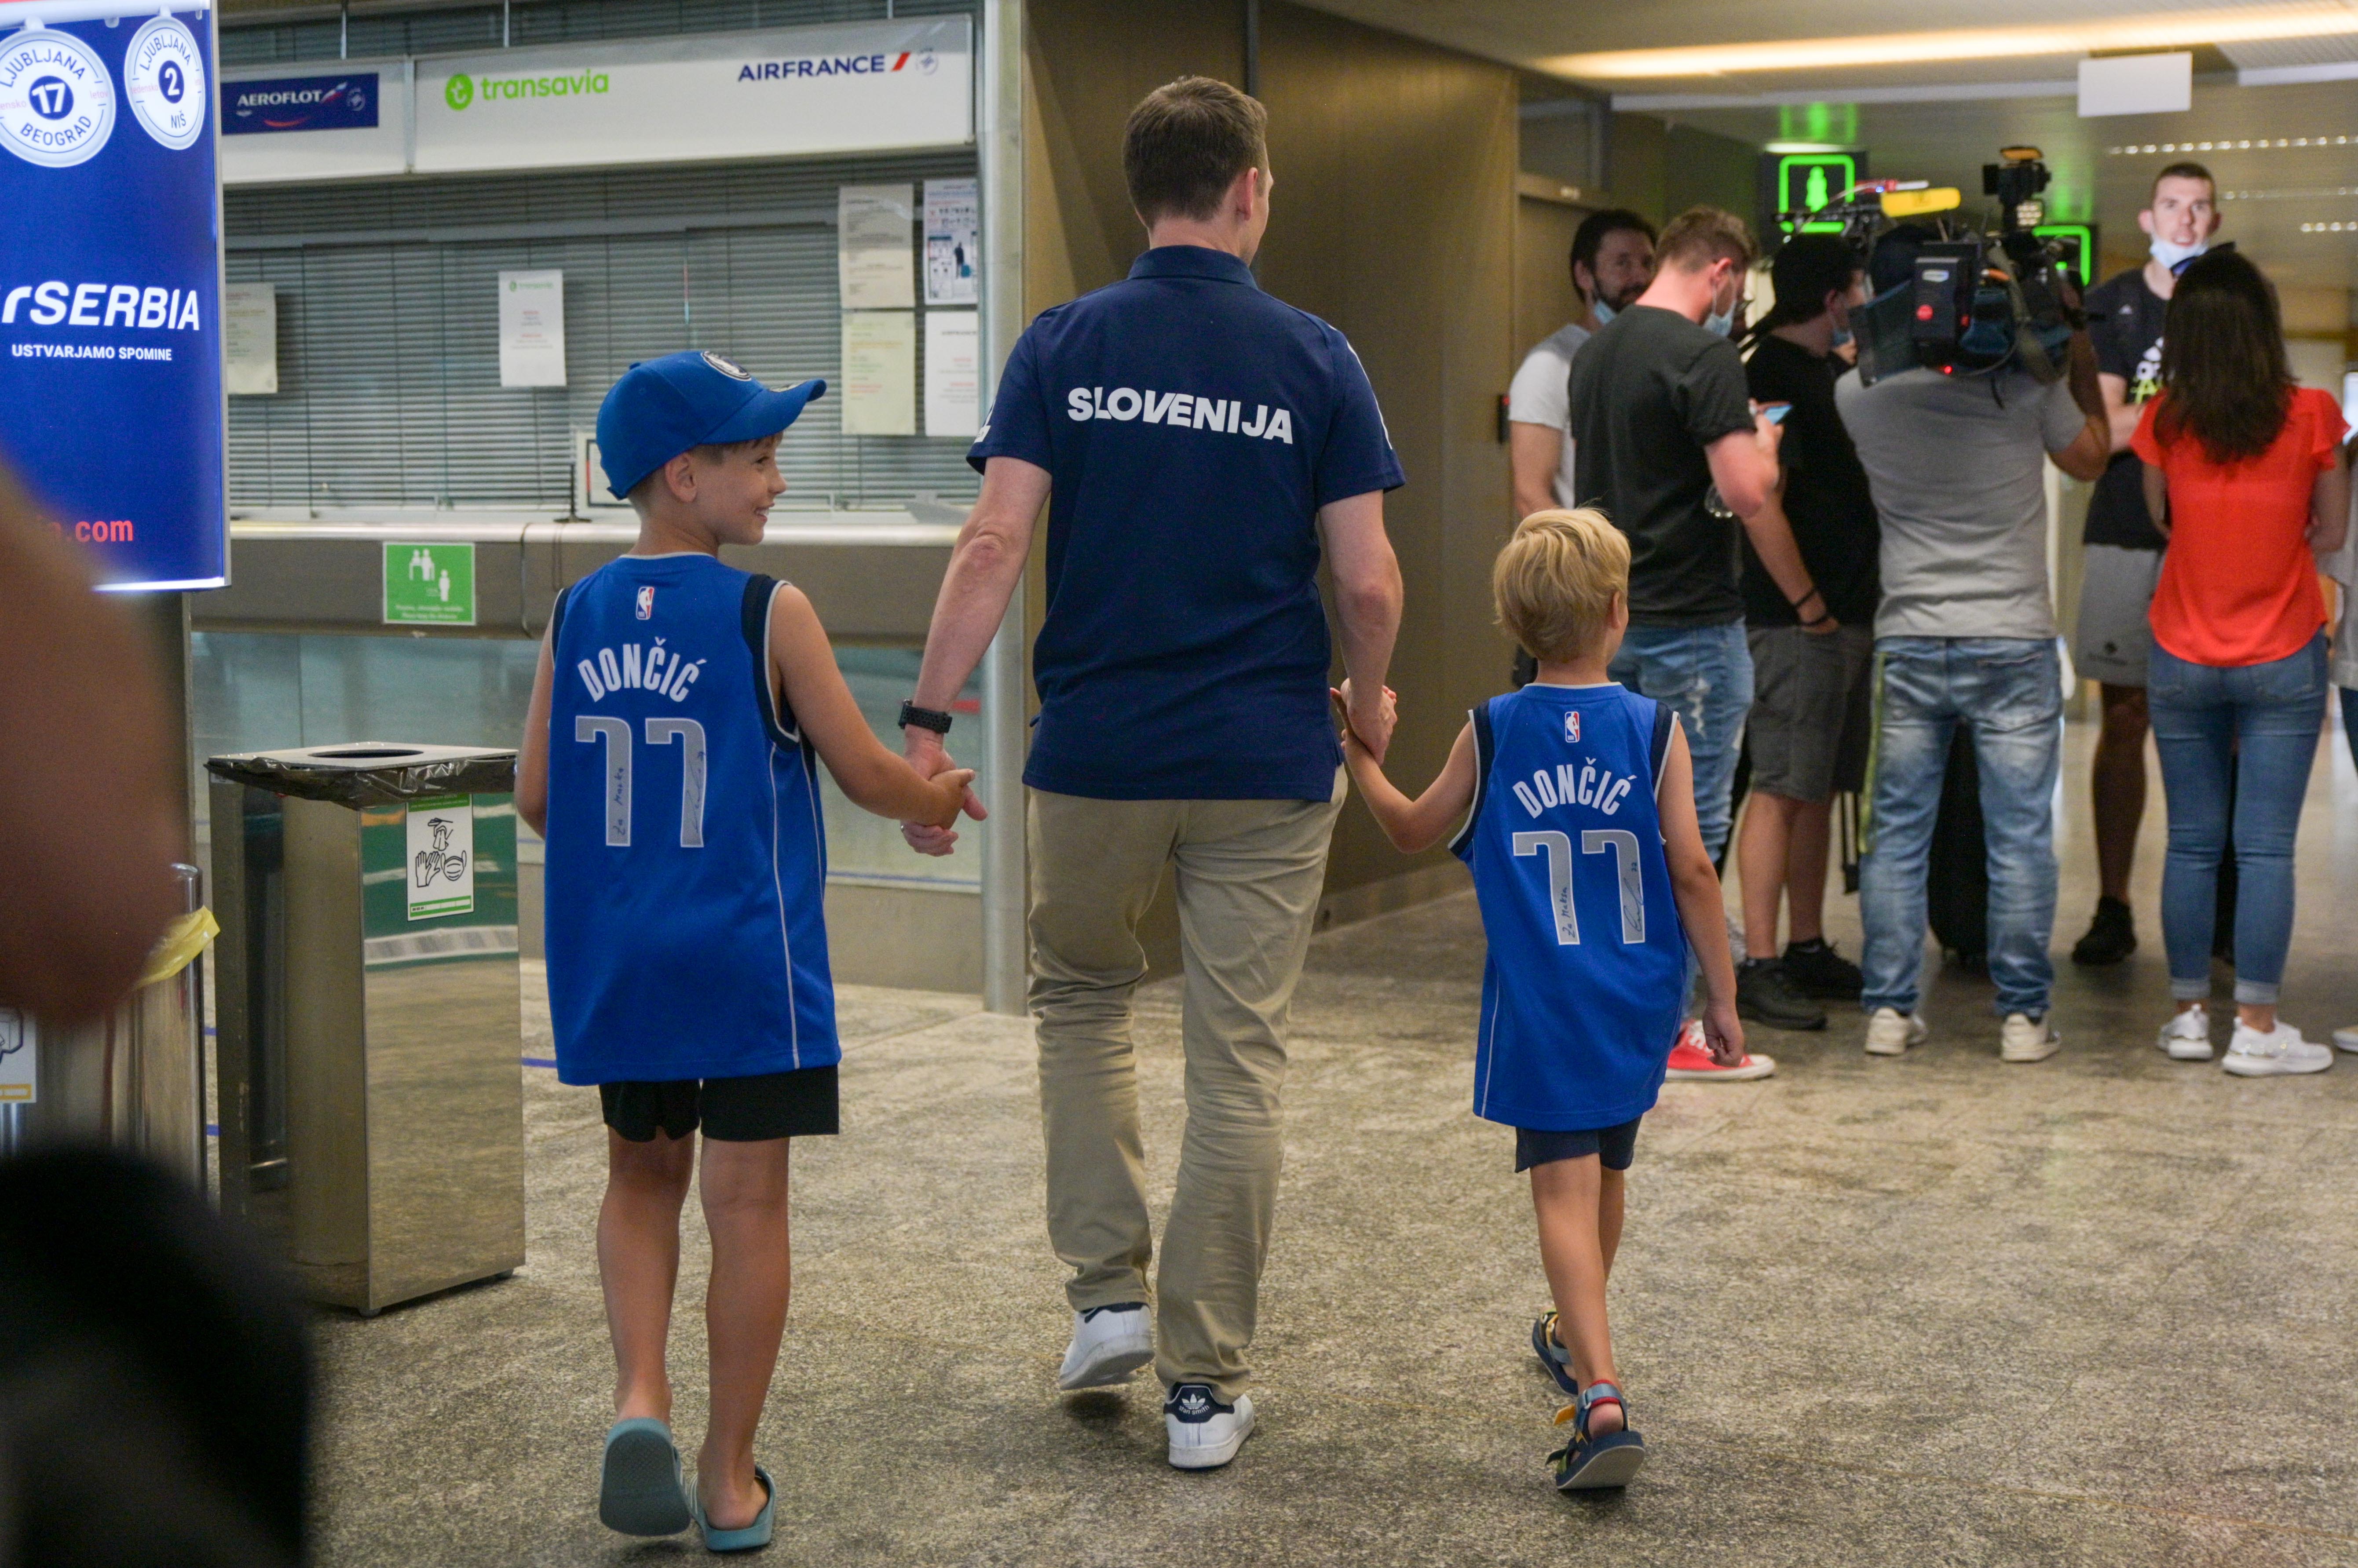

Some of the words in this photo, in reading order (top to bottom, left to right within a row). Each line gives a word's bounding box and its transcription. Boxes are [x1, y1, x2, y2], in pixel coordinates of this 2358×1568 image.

[0, 48, 85, 88] LJUBLJANA
[139, 34, 191, 71] LJUBLJANA
[738, 54, 885, 82] AIRFRANCE
[165, 67, 180, 96] 2
[481, 68, 610, 100] transavia
[0, 99, 27, 110] ensko
[31, 82, 66, 114] 17
[237, 89, 323, 107] AEROFLOT
[20, 116, 91, 146] BEOGRAD
[171, 110, 186, 129] NIŠ
[0, 281, 200, 331] rSERBIA
[12, 344, 115, 359] USTVARJAMO
[118, 346, 172, 361] SPOMINE
[1067, 387, 1293, 445] SLOVENIJA
[577, 636, 707, 703] DONČIĆ
[575, 715, 707, 848] 77
[1512, 756, 1638, 819] DONČIĆ
[1512, 829, 1645, 945] 77
[1179, 1405, 1190, 1415] stan
[1192, 1405, 1210, 1415] smith
